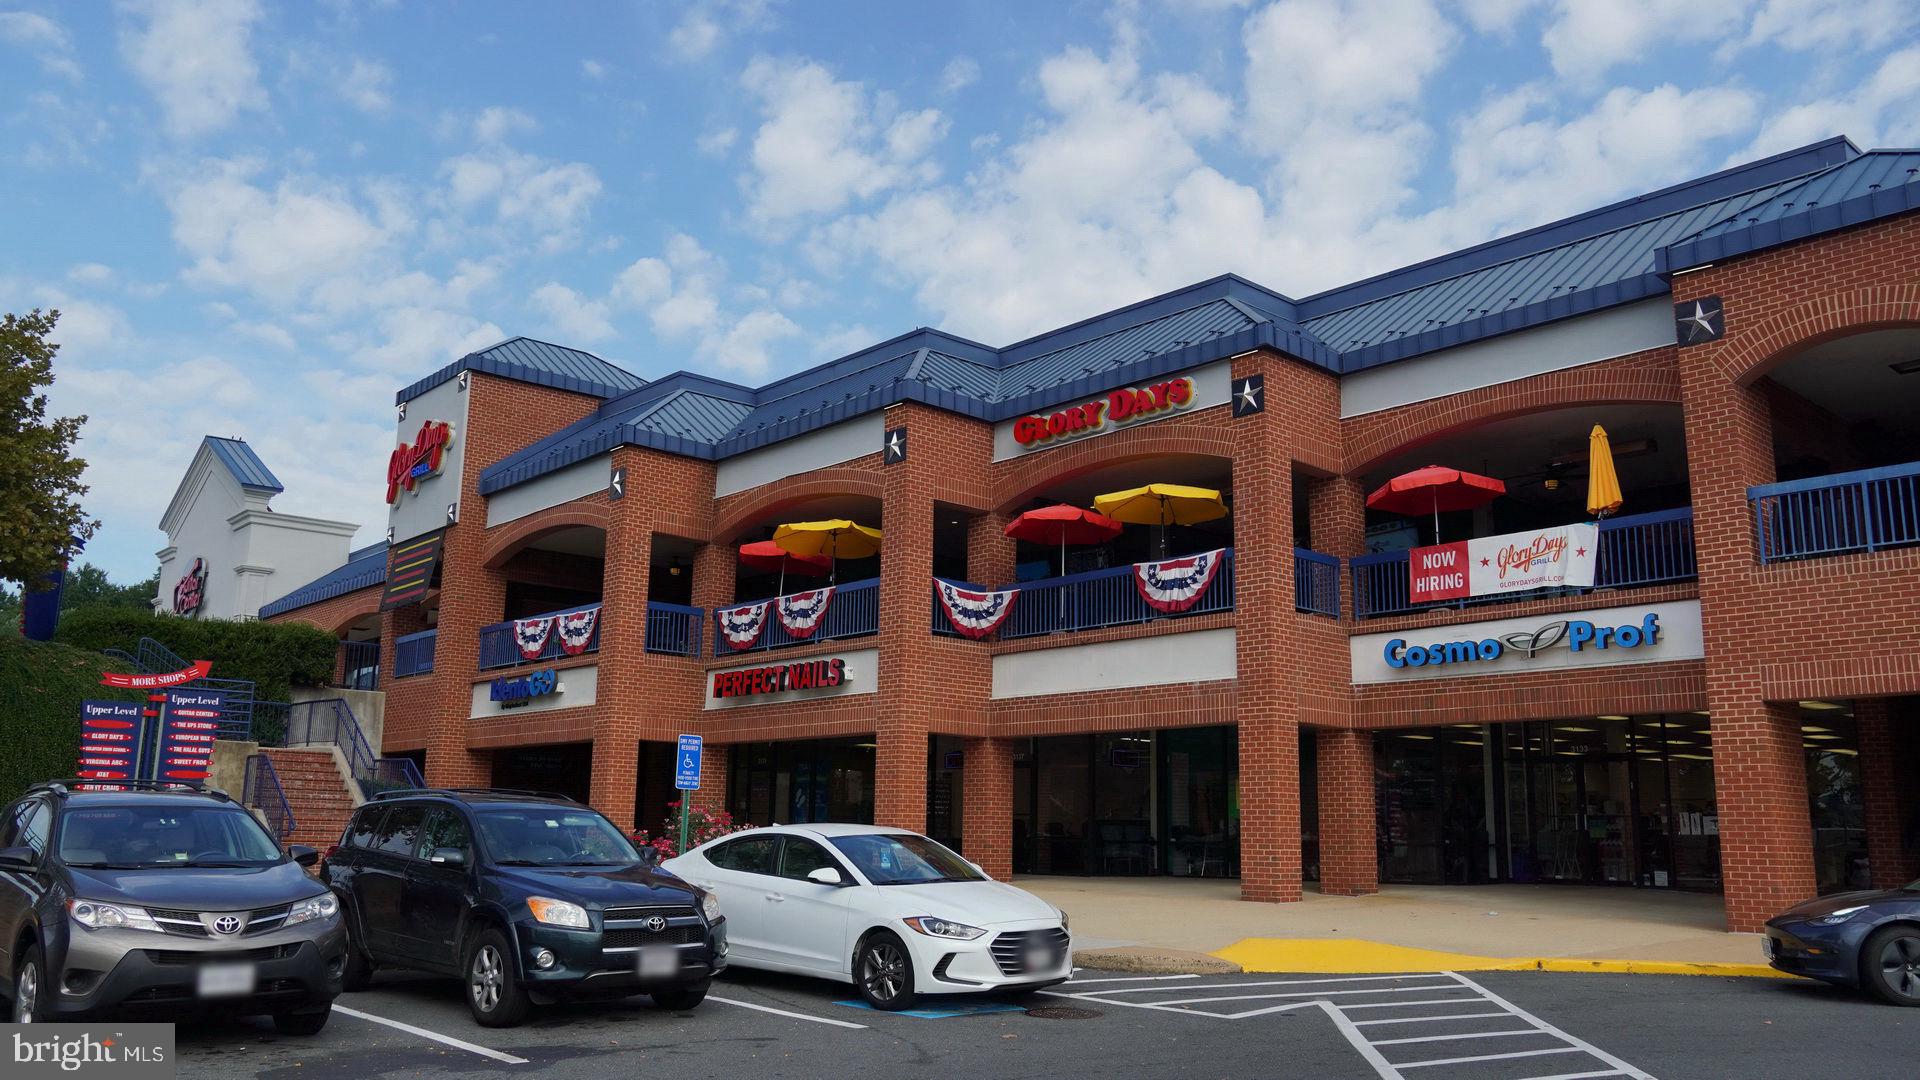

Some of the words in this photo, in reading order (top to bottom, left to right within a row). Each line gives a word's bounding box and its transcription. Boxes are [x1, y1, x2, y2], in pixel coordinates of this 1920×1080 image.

[1013, 402, 1104, 445] GLORY
[1108, 378, 1191, 421] DAYS
[386, 442, 419, 504] Glory
[416, 420, 450, 470] Days
[410, 462, 431, 478] GRILL
[1422, 550, 1457, 569] NOW
[1497, 544, 1532, 579] Glory
[1532, 533, 1568, 562] Days
[1530, 557, 1551, 566] GRILL
[1416, 573, 1464, 593] HIRING
[1384, 637, 1504, 669] Cosmo
[1570, 613, 1661, 652] Prof
[132, 677, 156, 686] MORE
[158, 673, 186, 685] SHOPS
[713, 665, 785, 698] PERFECT
[788, 658, 845, 690] NAILS
[172, 694, 196, 706] Upper
[197, 696, 219, 705] Level
[86, 705, 113, 716] Upper
[114, 706, 138, 716] Level
[1570, 745, 1589, 753] 3133
